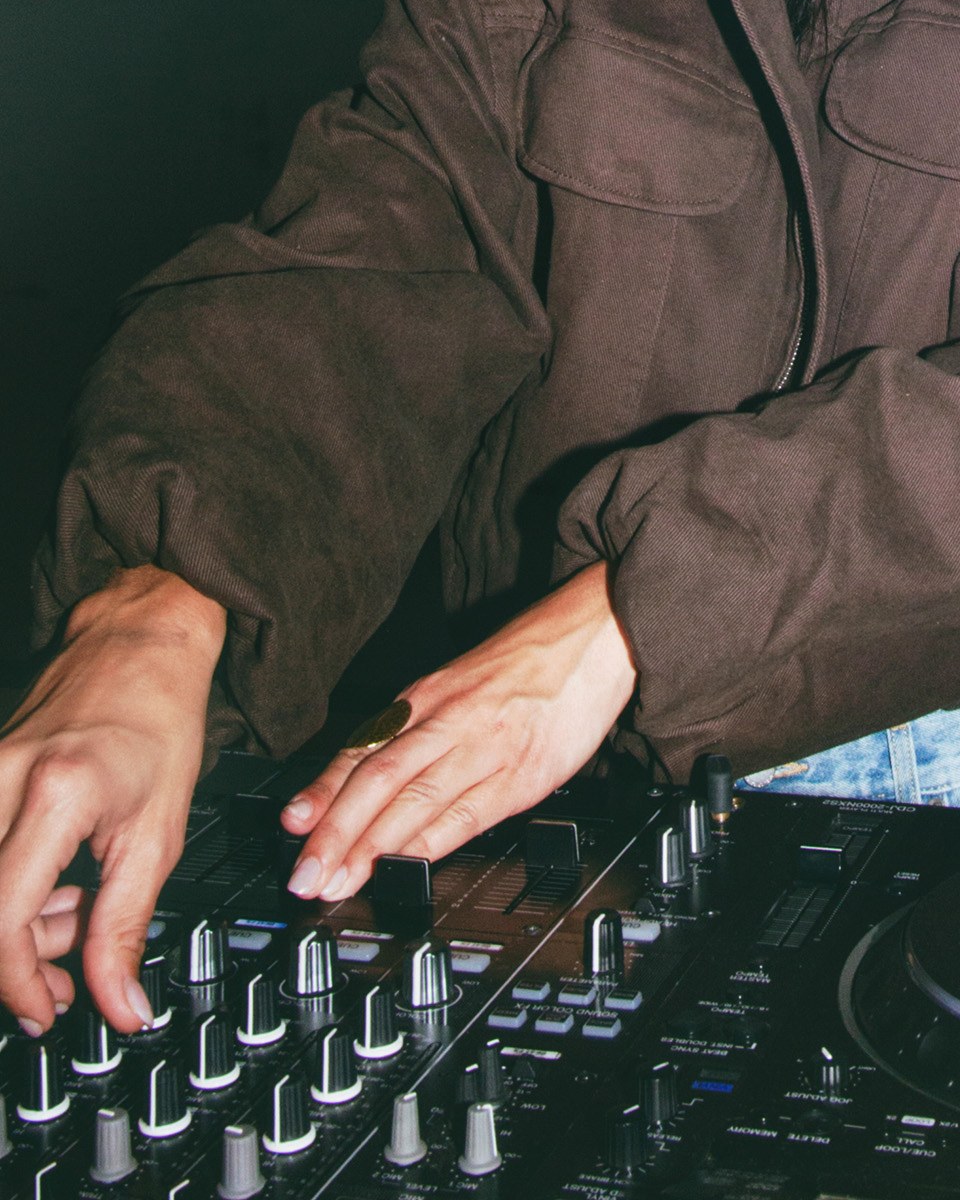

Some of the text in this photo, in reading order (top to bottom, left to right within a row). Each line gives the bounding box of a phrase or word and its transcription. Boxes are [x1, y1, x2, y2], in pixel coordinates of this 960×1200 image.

[783, 1090, 853, 1105] JOG ADJUST
[726, 1125, 778, 1138] MEMORY
[787, 1132, 830, 1145] DELETE
[896, 1137, 925, 1147] CALL
[874, 1144, 937, 1158] CUE/LOOP
[561, 1183, 605, 1195] ADJUST
